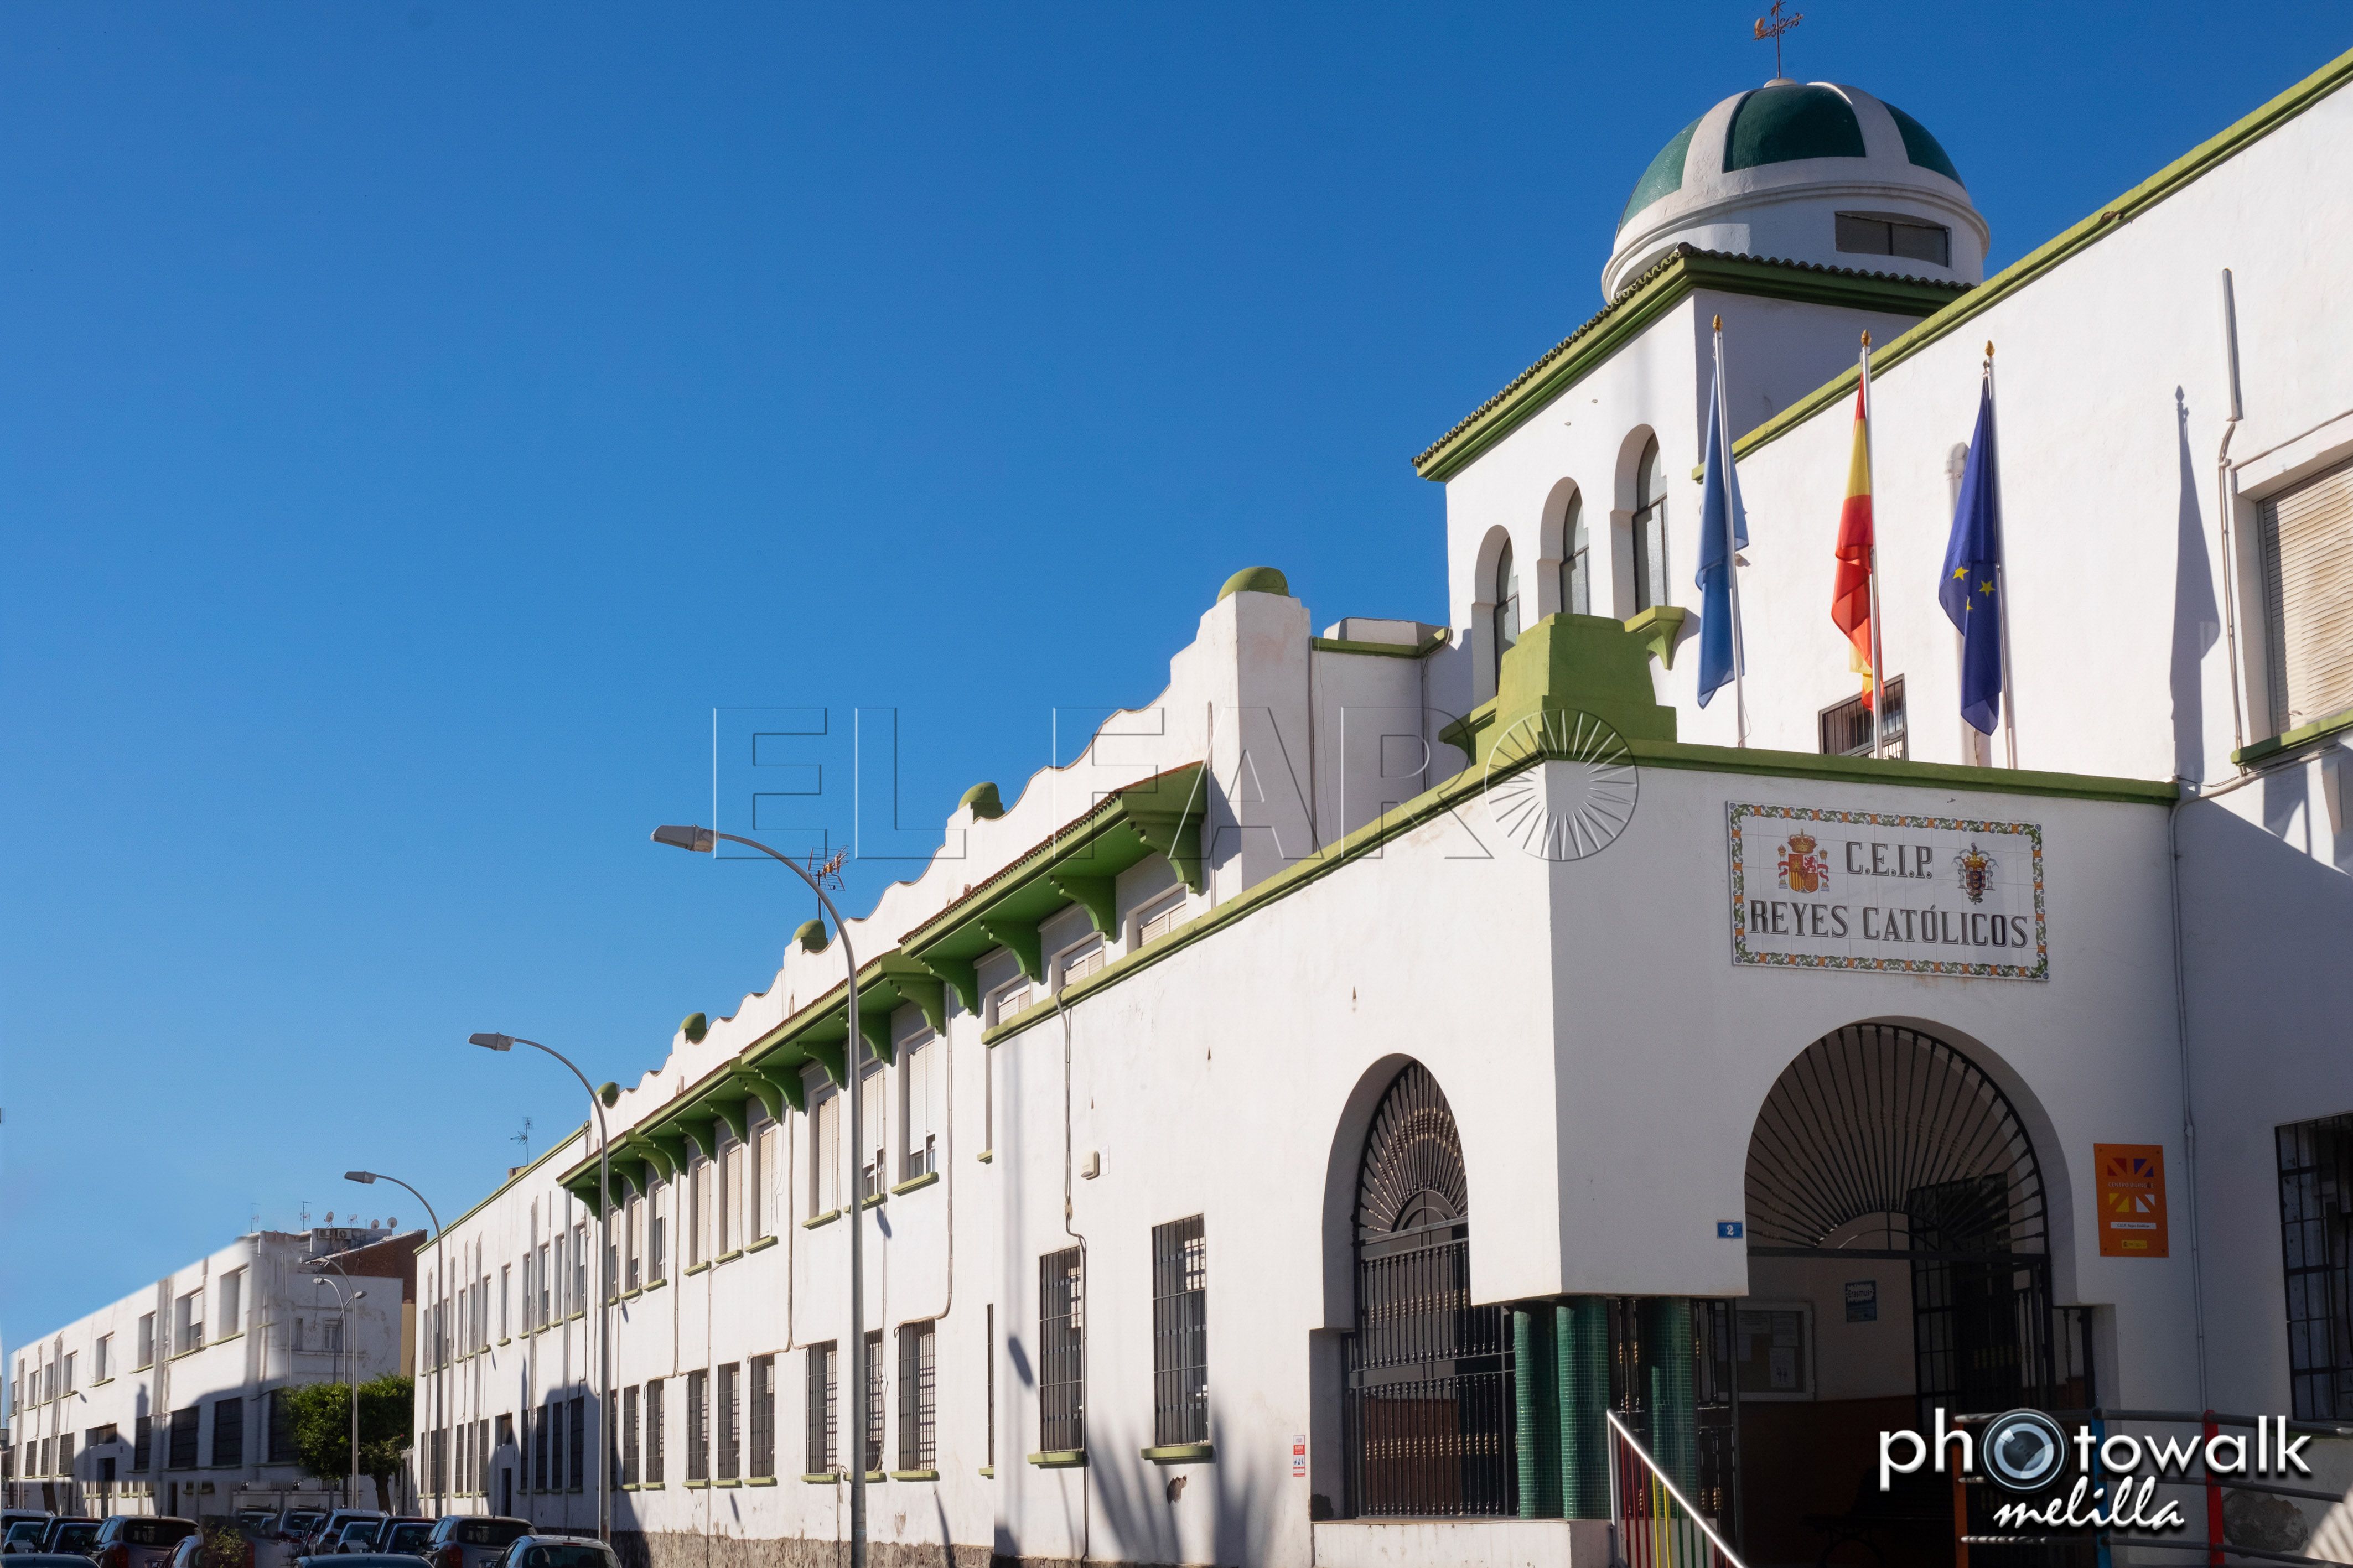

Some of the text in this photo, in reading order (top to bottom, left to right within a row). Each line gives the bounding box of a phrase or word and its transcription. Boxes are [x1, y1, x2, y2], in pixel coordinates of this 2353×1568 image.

[1846, 840, 1933, 879] C.E.I.P.
[1749, 900, 2028, 948] REYES CATÓLICOS
[1727, 1224, 1734, 1235] 2
